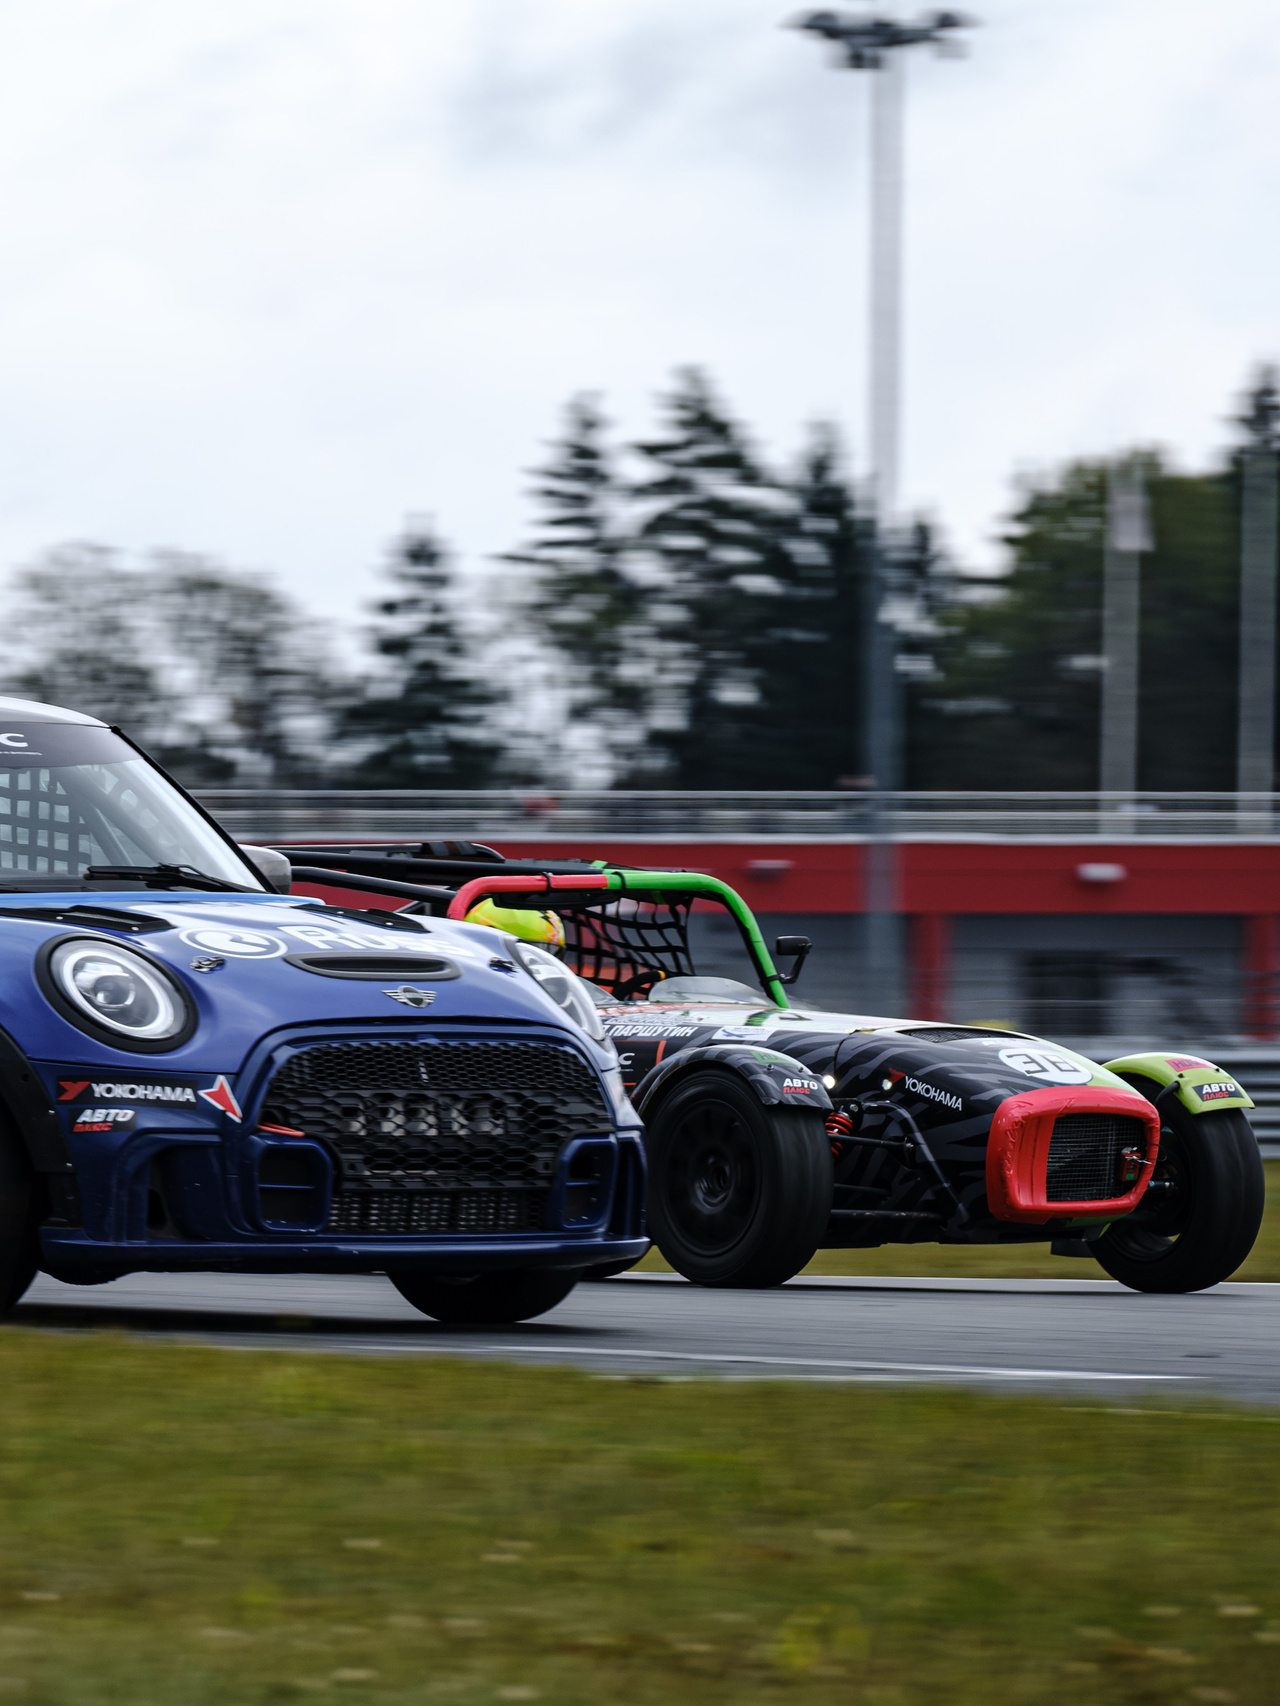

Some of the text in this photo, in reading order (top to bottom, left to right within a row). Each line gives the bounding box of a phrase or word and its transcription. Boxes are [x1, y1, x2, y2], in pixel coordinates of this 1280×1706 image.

[1006, 1053, 1081, 1075] 38
[783, 1078, 818, 1090] АВТО
[1202, 1083, 1236, 1094] АВТО
[91, 1083, 196, 1102] YOKOHAMA
[783, 1086, 810, 1095] ПЛЮС
[905, 1076, 962, 1111] YOKOHAMA
[1203, 1091, 1229, 1100] ПЛЮС
[76, 1109, 135, 1122] АВТО
